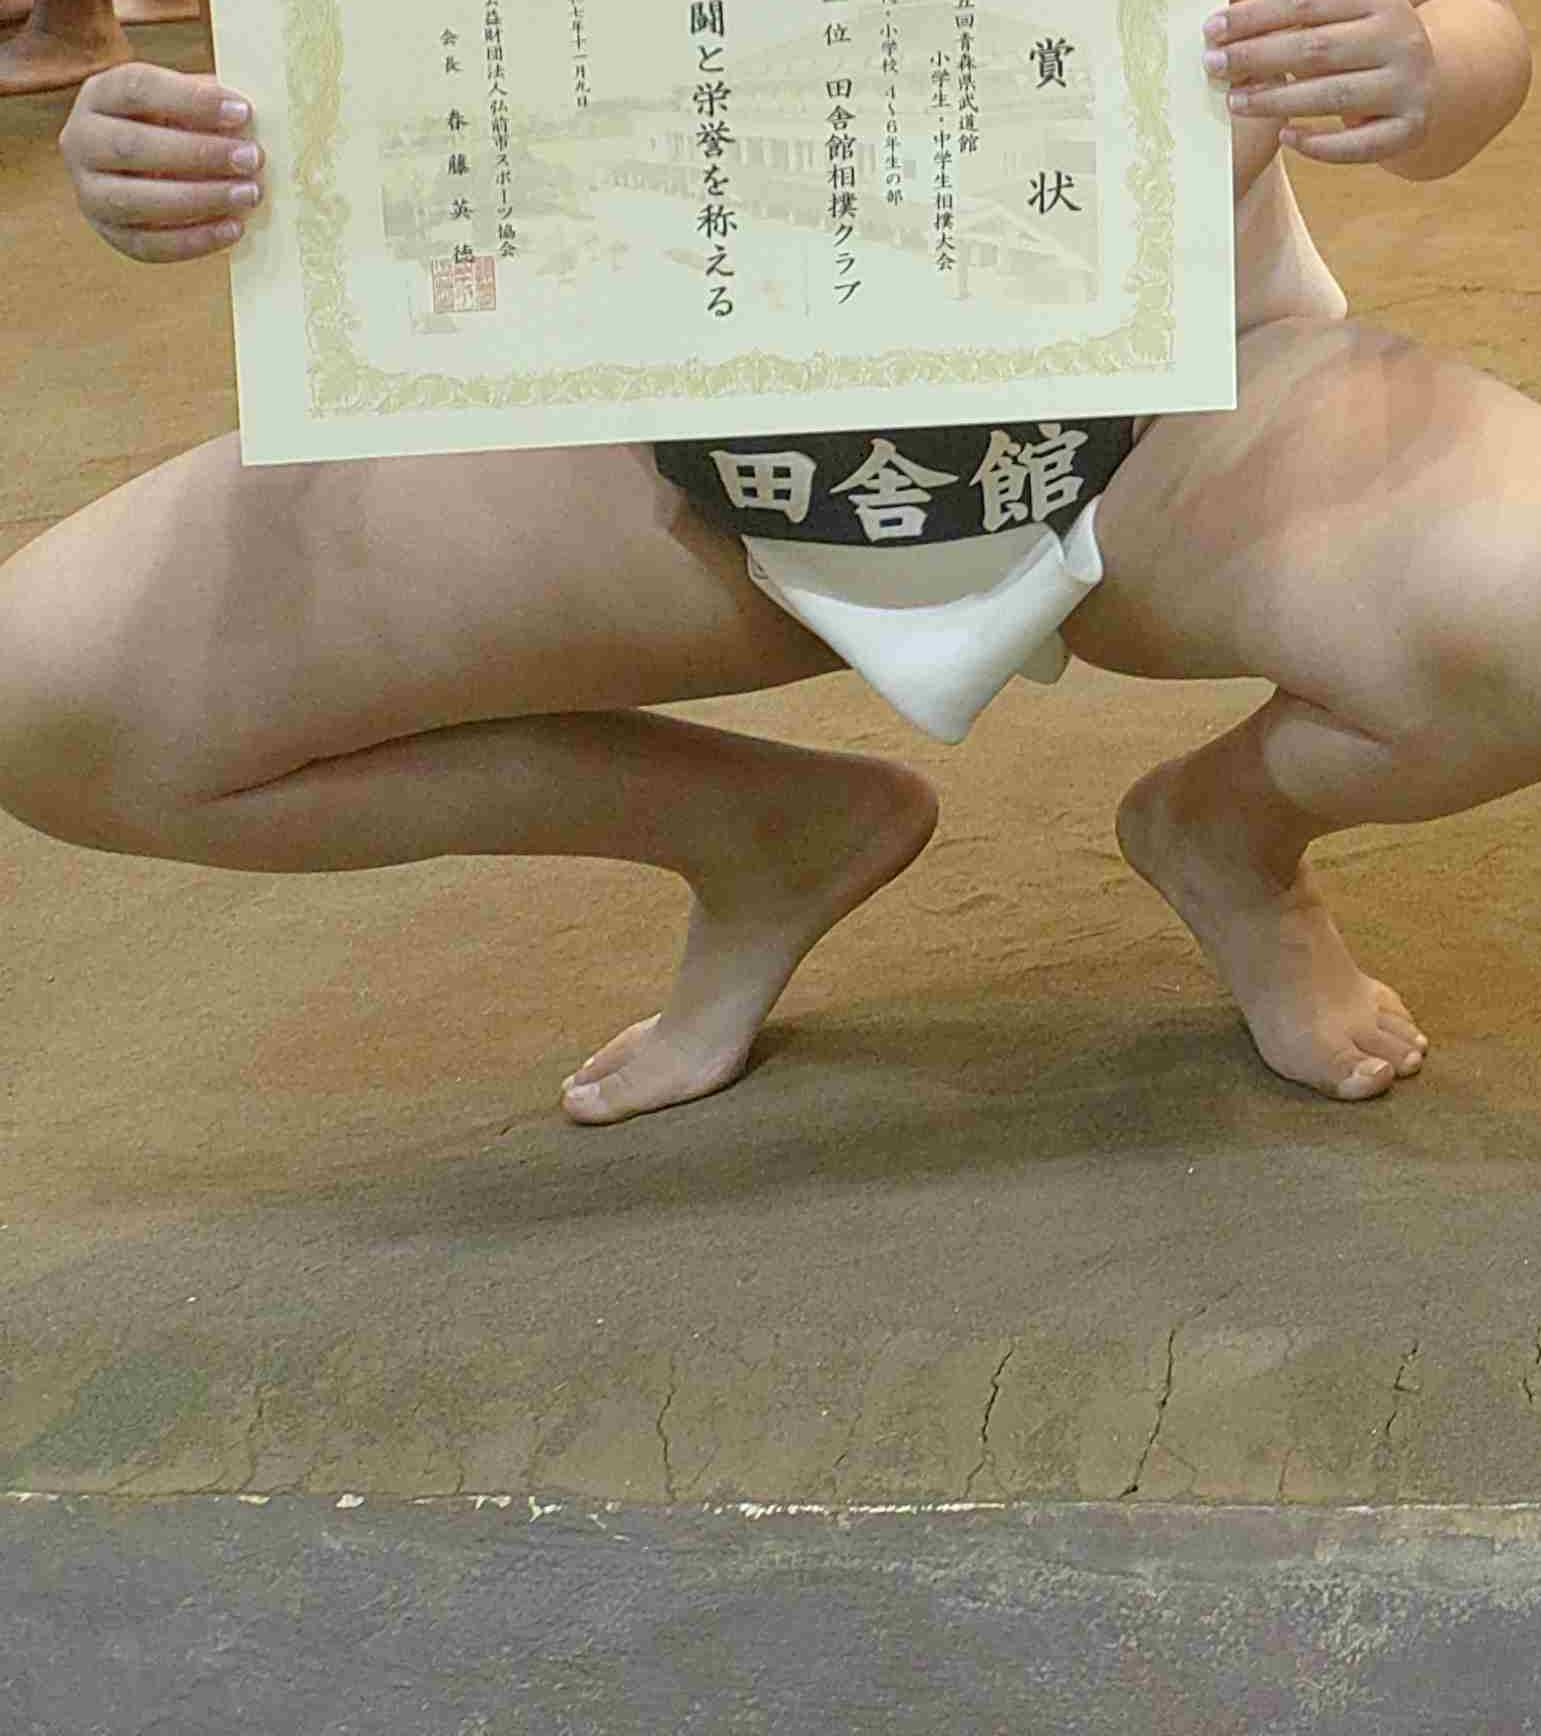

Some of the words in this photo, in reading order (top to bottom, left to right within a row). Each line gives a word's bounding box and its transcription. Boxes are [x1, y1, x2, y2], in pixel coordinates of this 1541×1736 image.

[440, 27, 462, 73] 会長
[824, 77, 862, 305] 田舎館相撲クラブ
[709, 423, 1089, 543] 田舎館
